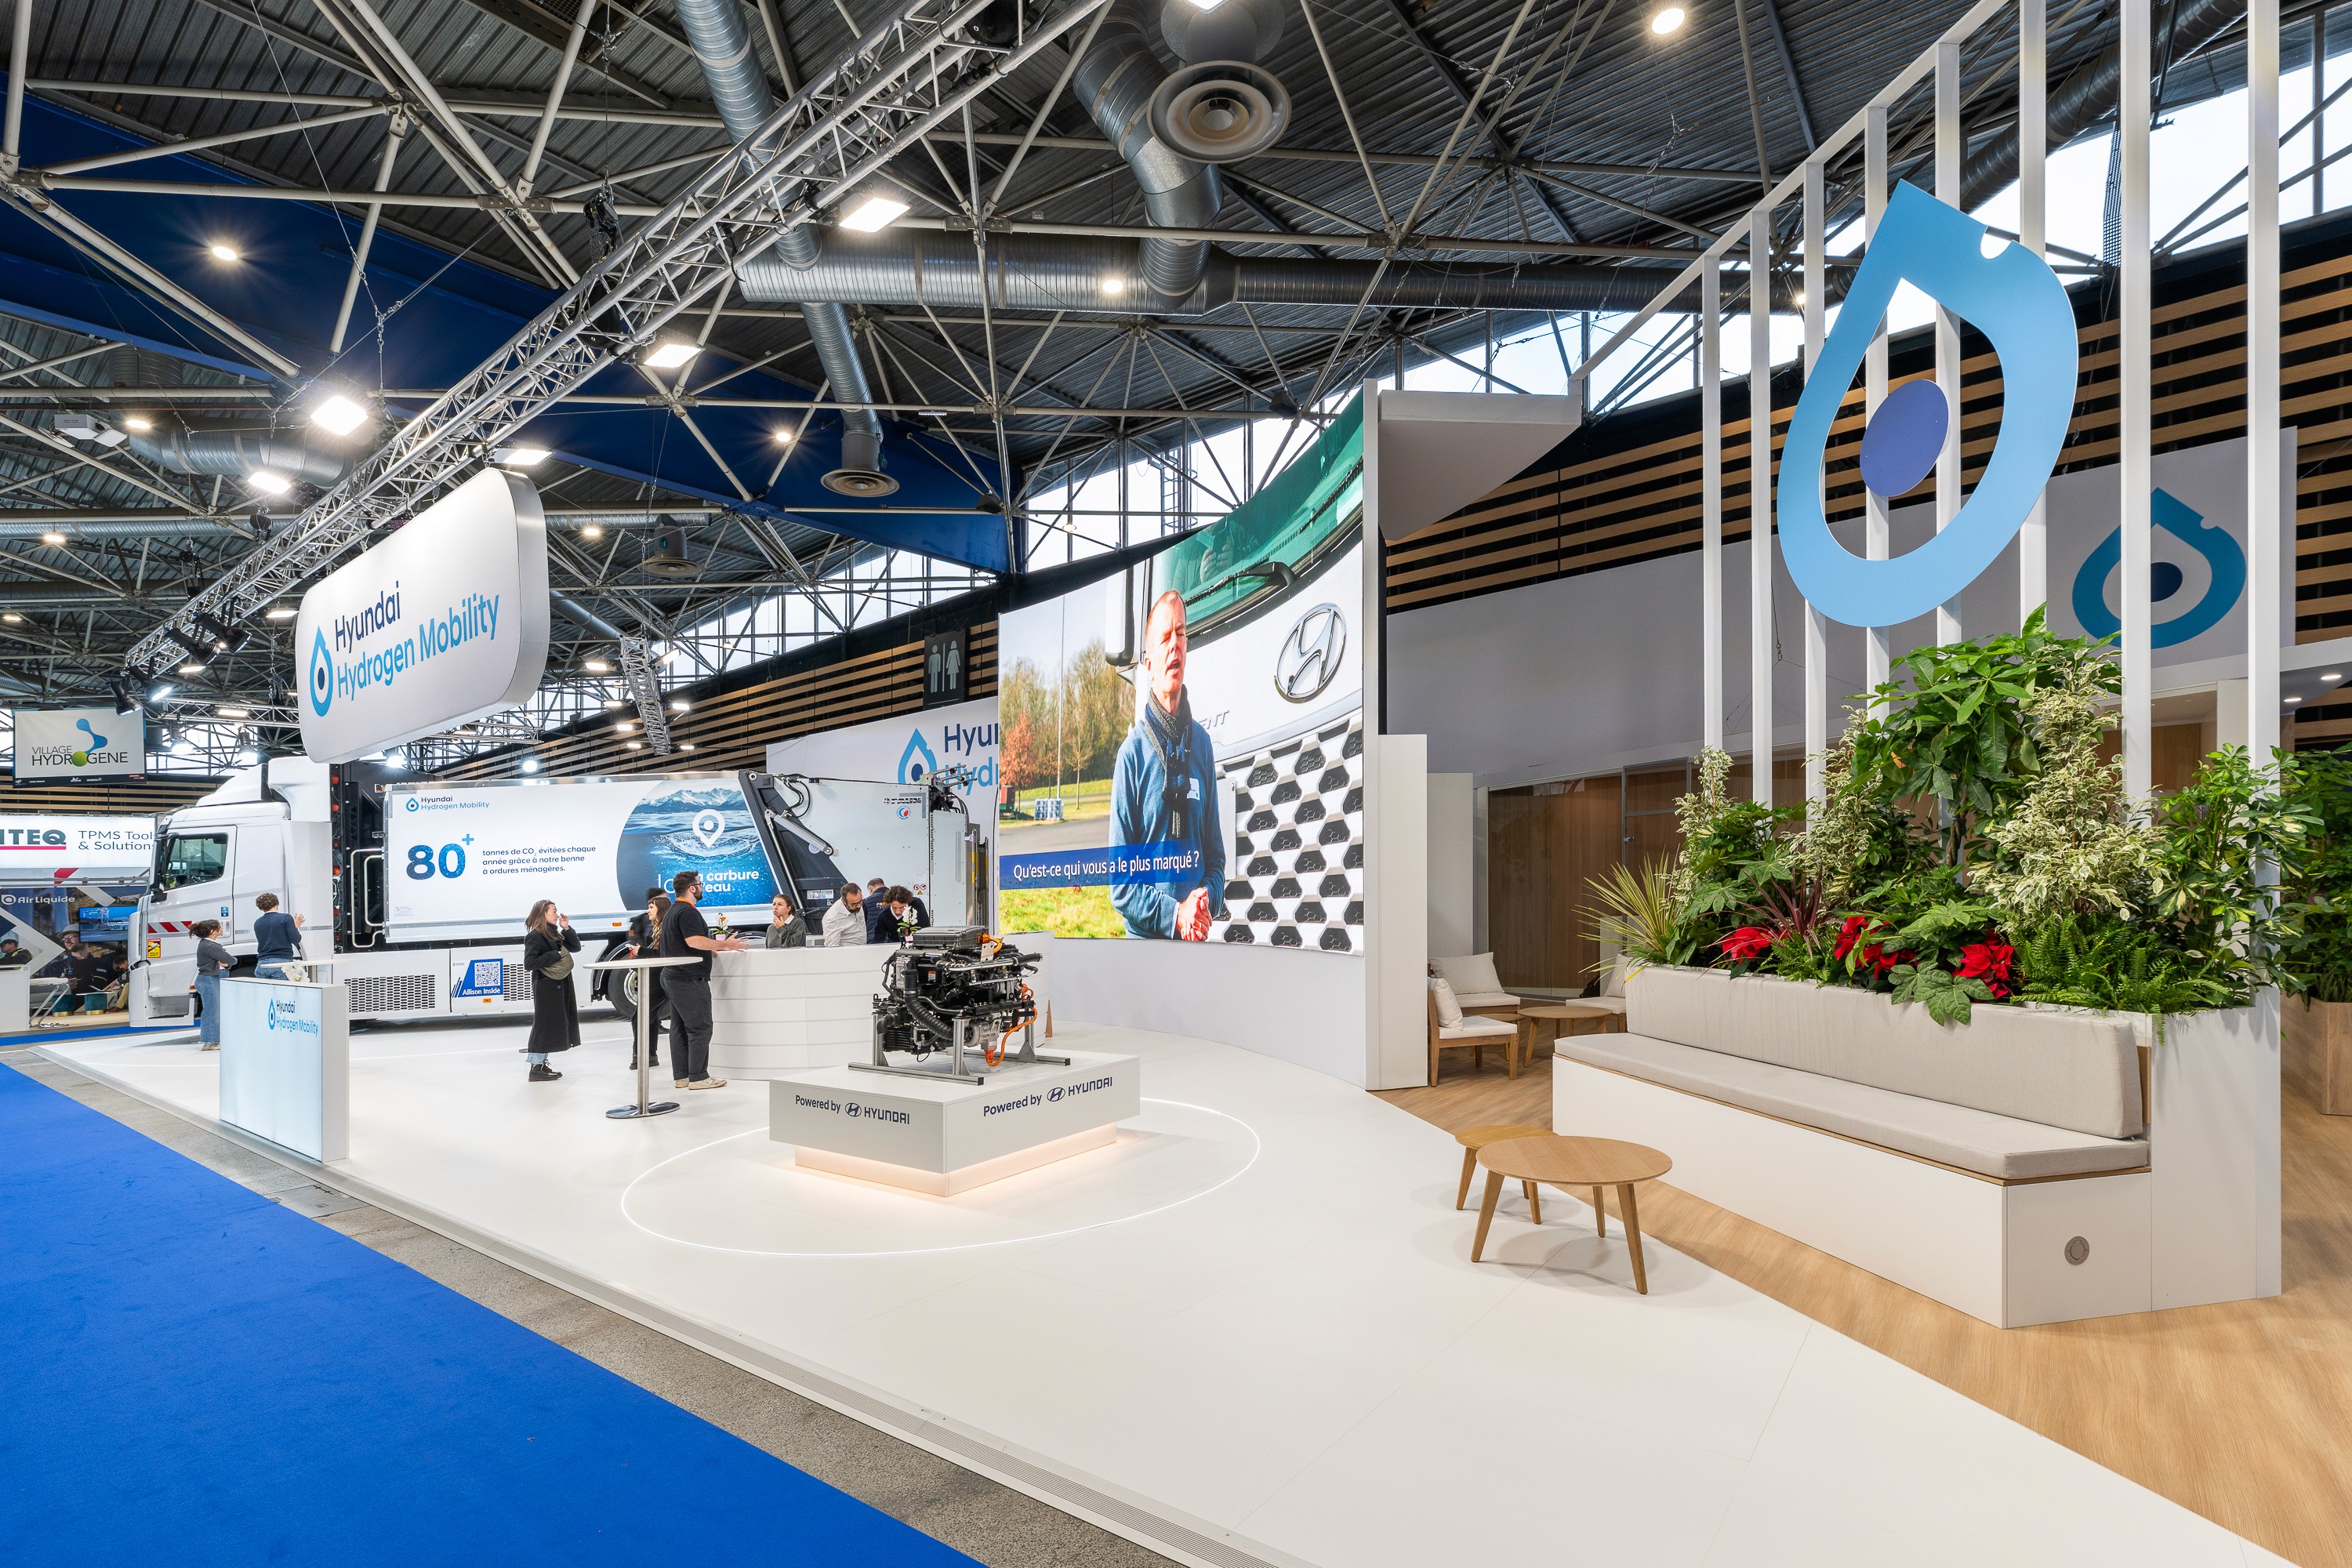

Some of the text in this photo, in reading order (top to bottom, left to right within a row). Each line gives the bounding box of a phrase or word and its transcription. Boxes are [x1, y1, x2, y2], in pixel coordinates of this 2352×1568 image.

[335, 580, 401, 654] Hyundai
[337, 593, 499, 702] Hydrogen Mobility
[31, 745, 73, 755] VILLAGE
[32, 751, 129, 767] HYDROGENE
[0, 829, 67, 845] TEQ
[78, 830, 154, 840] TPMS Tool
[78, 841, 154, 851] & Solution
[567, 845, 596, 854] chaque
[509, 857, 531, 866] grâce
[1013, 850, 1200, 881] Qu'est-ce qui vous a le plus marqué ?
[521, 866, 566, 875] ménagères.
[706, 869, 760, 881] carbure
[35, 895, 75, 905] Liquide
[276, 999, 296, 1014] Hyundai
[276, 1016, 319, 1037] Hydrogen Mobility
[983, 1076, 1112, 1117] Powered by HYUNDAI
[795, 1094, 910, 1125] Powered by HYUNDAI
